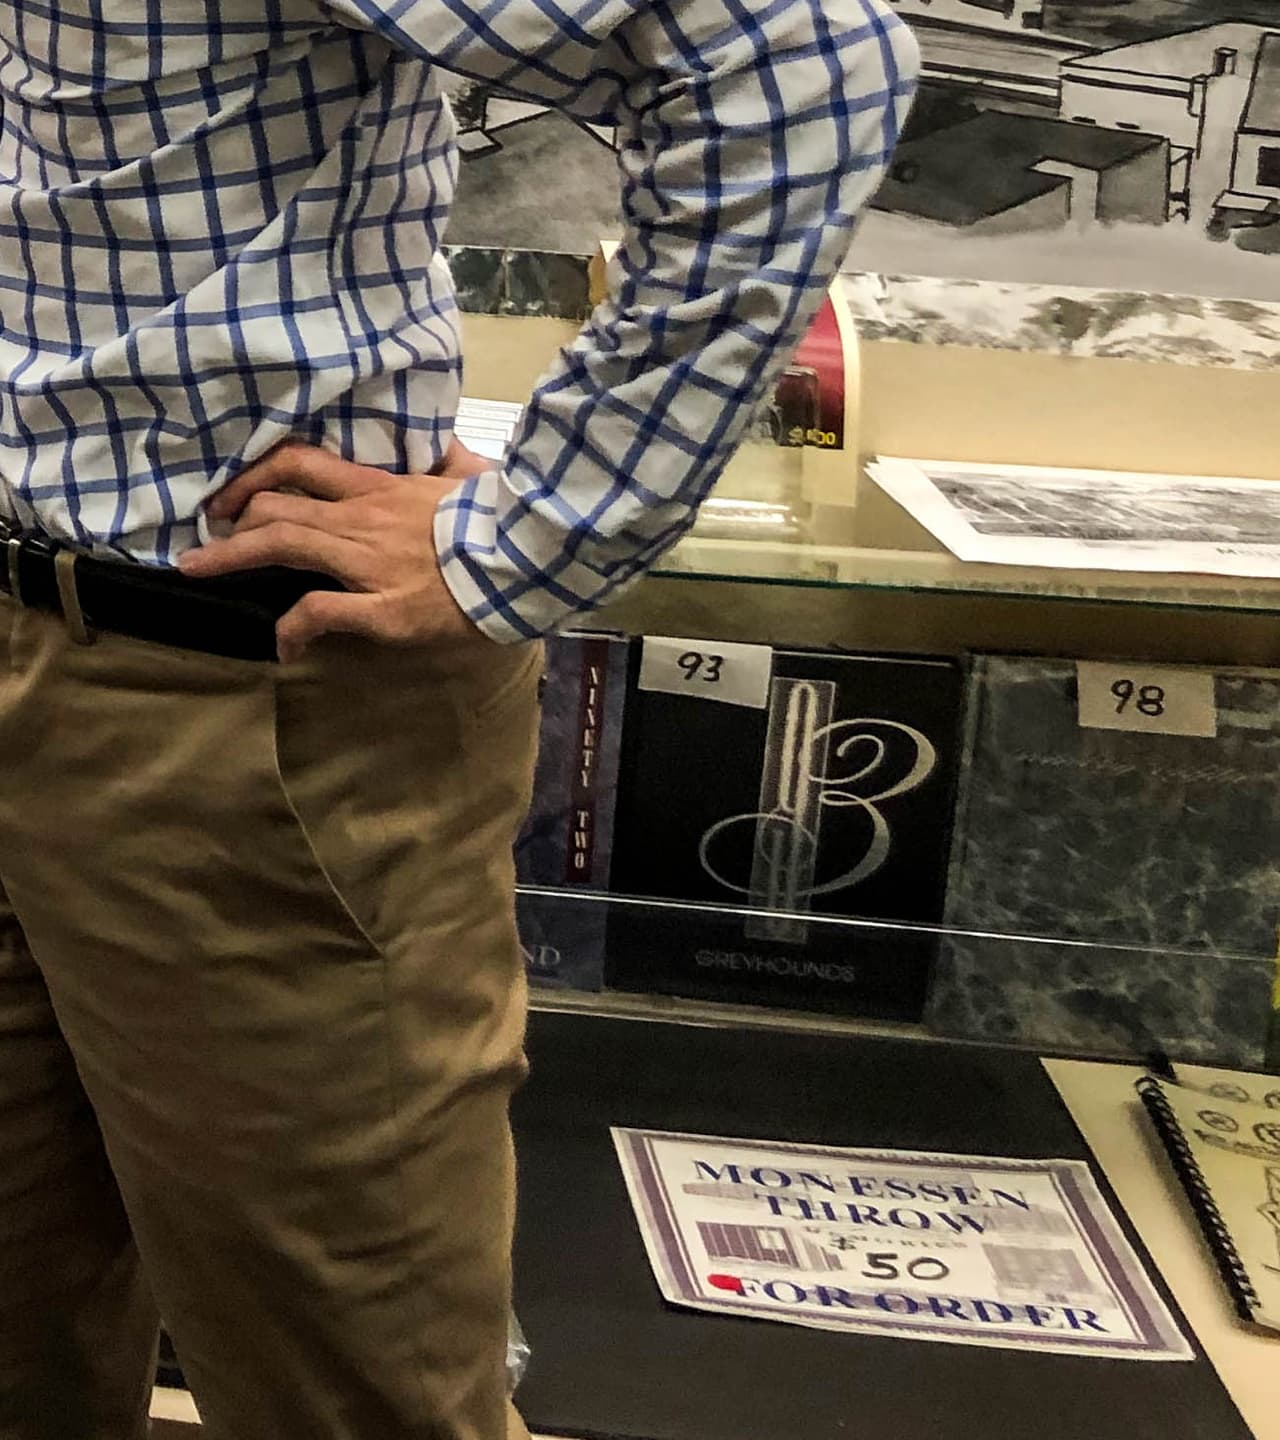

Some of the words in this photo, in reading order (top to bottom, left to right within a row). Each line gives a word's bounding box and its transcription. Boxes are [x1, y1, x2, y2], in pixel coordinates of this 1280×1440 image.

[677, 651, 724, 682] 93
[1111, 679, 1165, 716] 98
[695, 948, 855, 982] GREYHOUNDS
[692, 1159, 1032, 1211] MONESSEN
[754, 1192, 988, 1236] THROW
[737, 1277, 859, 1310] FOR
[873, 1290, 1111, 1334] ORDER
